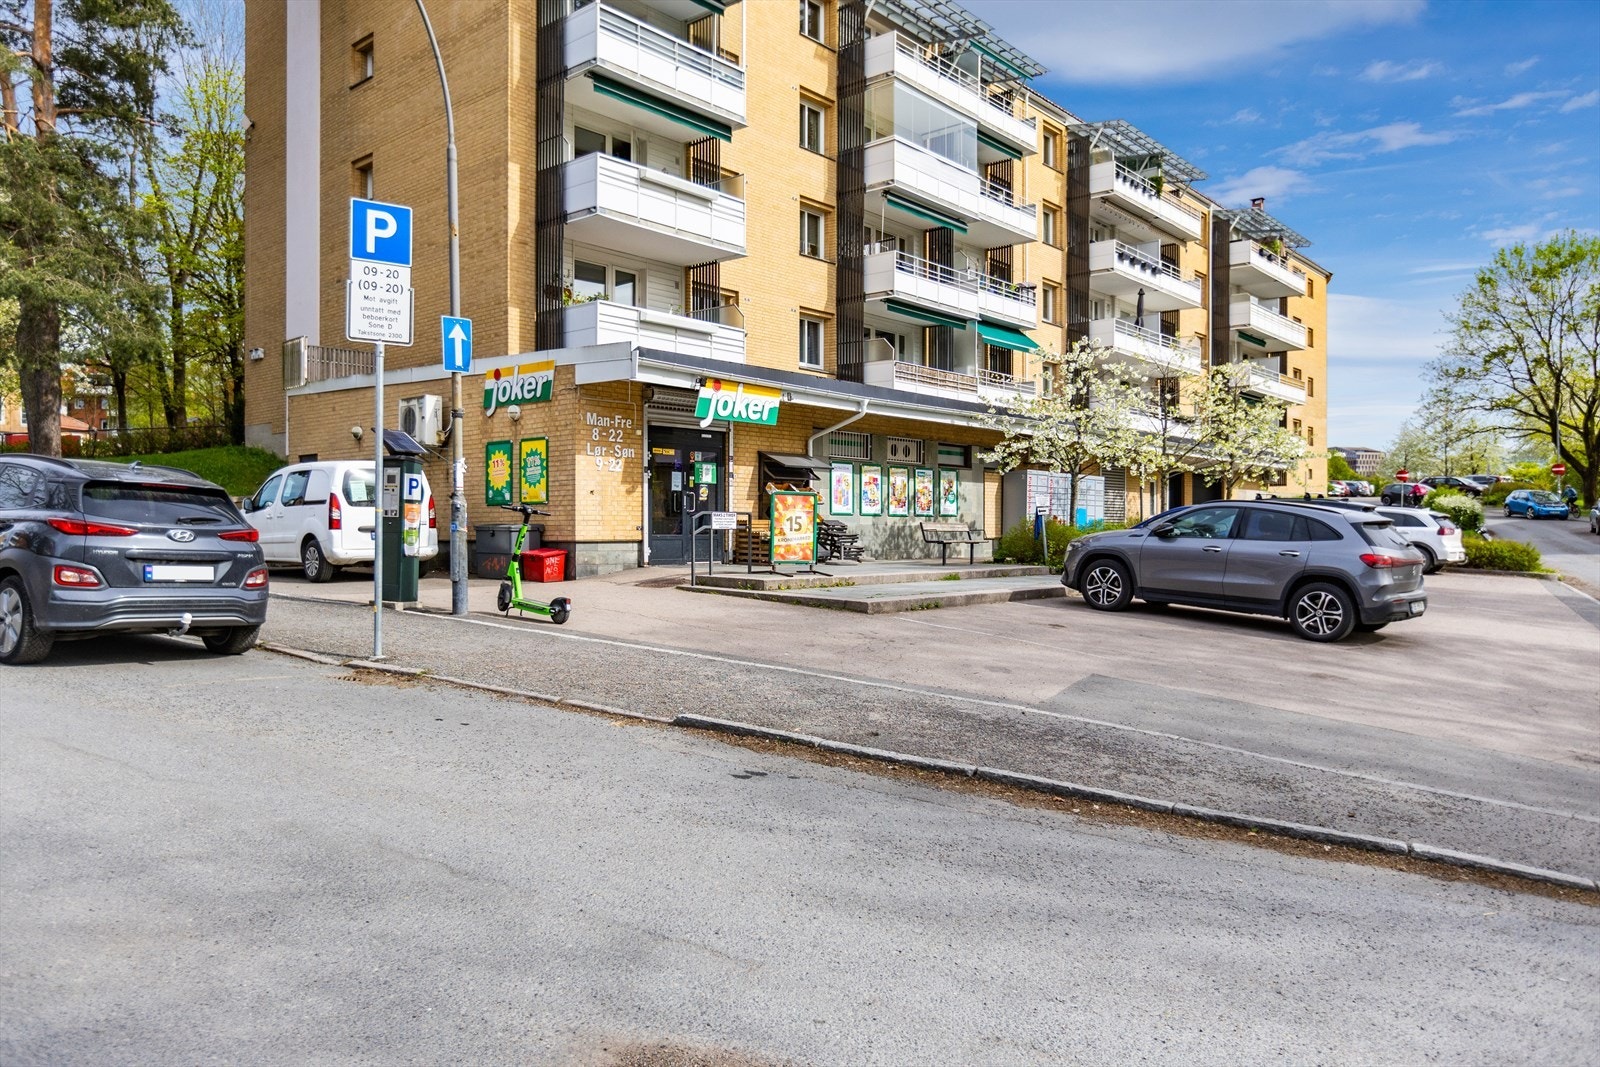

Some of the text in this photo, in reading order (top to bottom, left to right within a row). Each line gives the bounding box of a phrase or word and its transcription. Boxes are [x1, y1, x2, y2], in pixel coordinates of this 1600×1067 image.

[366, 208, 398, 254] P
[362, 313, 399, 323] beboerkort
[358, 329, 386, 337] Takstsone
[486, 364, 549, 417] joker
[699, 379, 776, 428] joker
[586, 411, 632, 429] Man-Fre
[408, 477, 419, 496] P
[785, 515, 803, 532] 15
